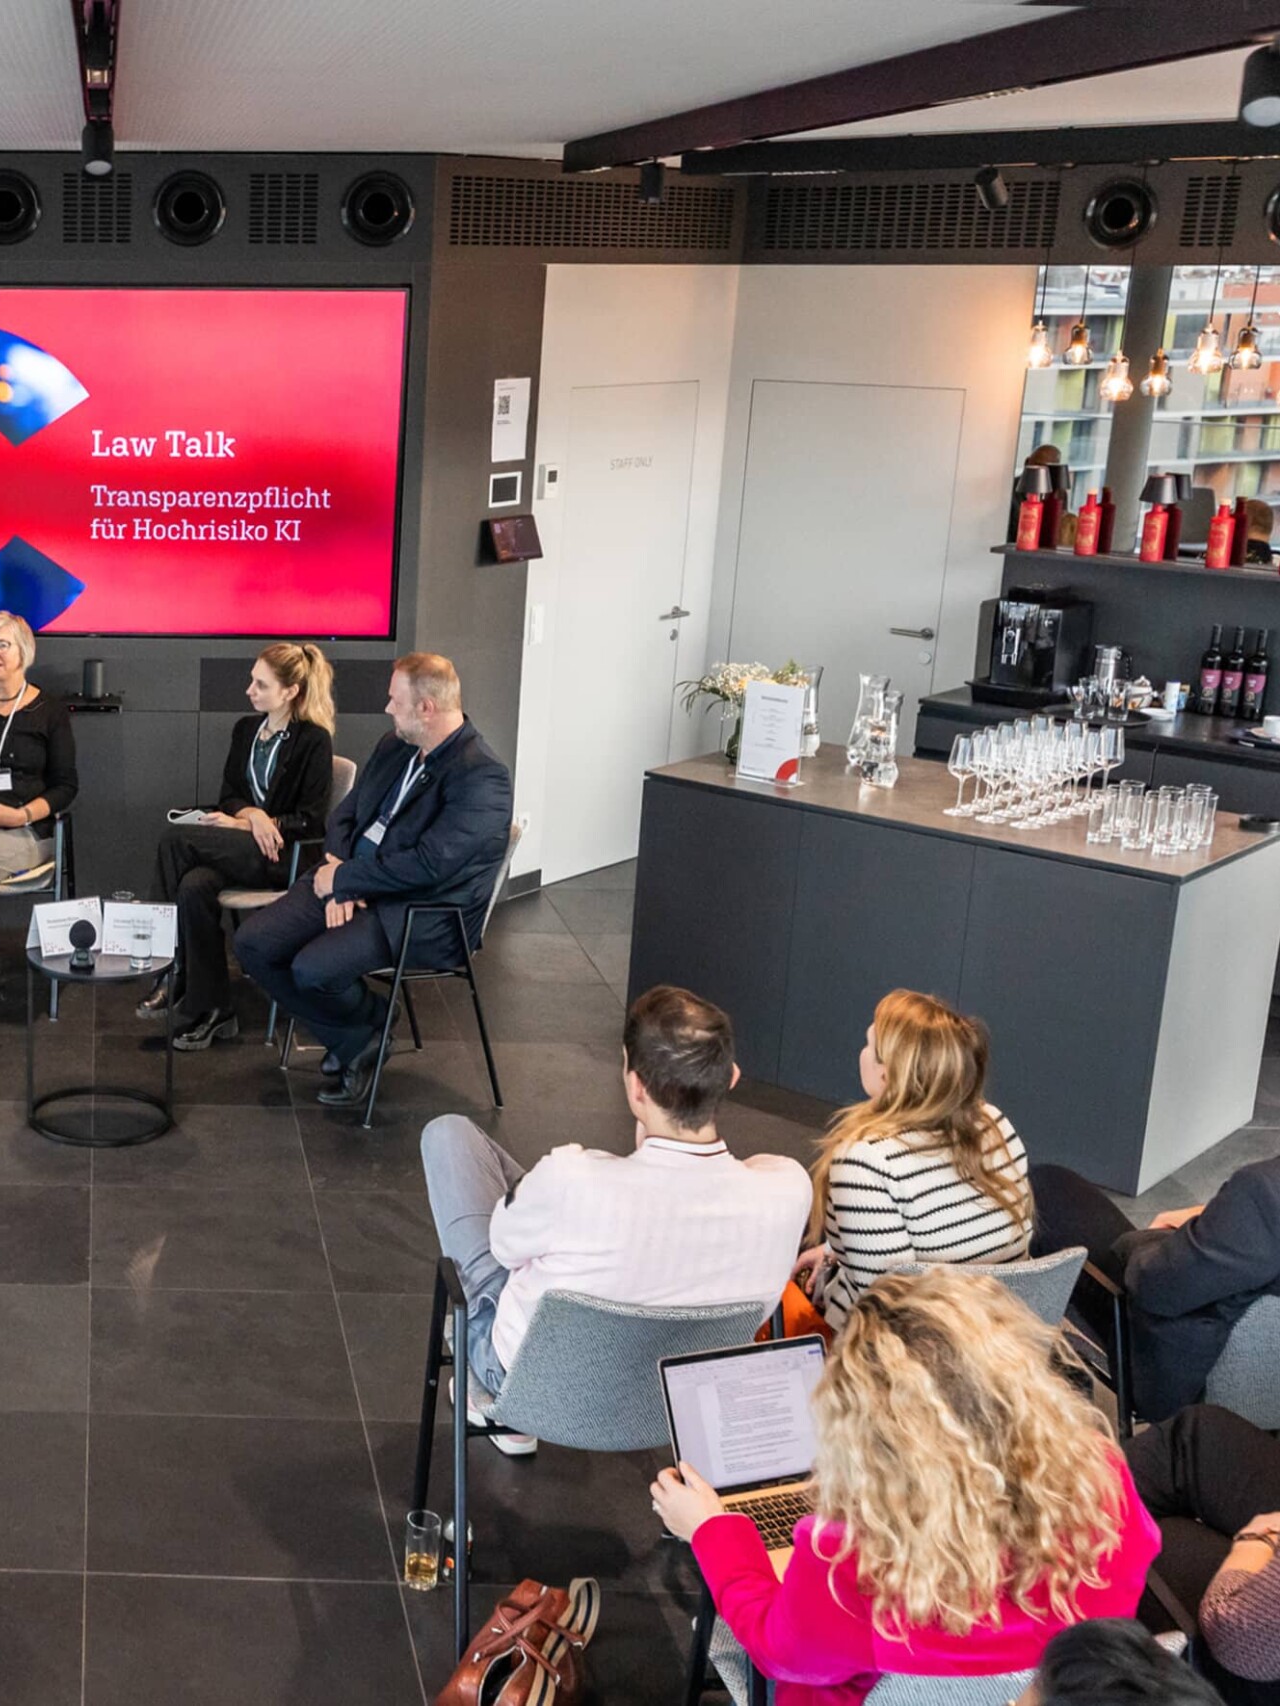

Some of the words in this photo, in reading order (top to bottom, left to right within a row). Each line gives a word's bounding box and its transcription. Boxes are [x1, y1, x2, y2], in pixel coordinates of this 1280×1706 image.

[91, 429, 158, 458] Law
[164, 430, 236, 458] Talk
[610, 457, 633, 471] STAFF
[90, 484, 332, 514] Transparenzpflicht
[90, 518, 127, 540] für
[132, 518, 269, 542] Hochrisiko
[275, 519, 302, 542] KI
